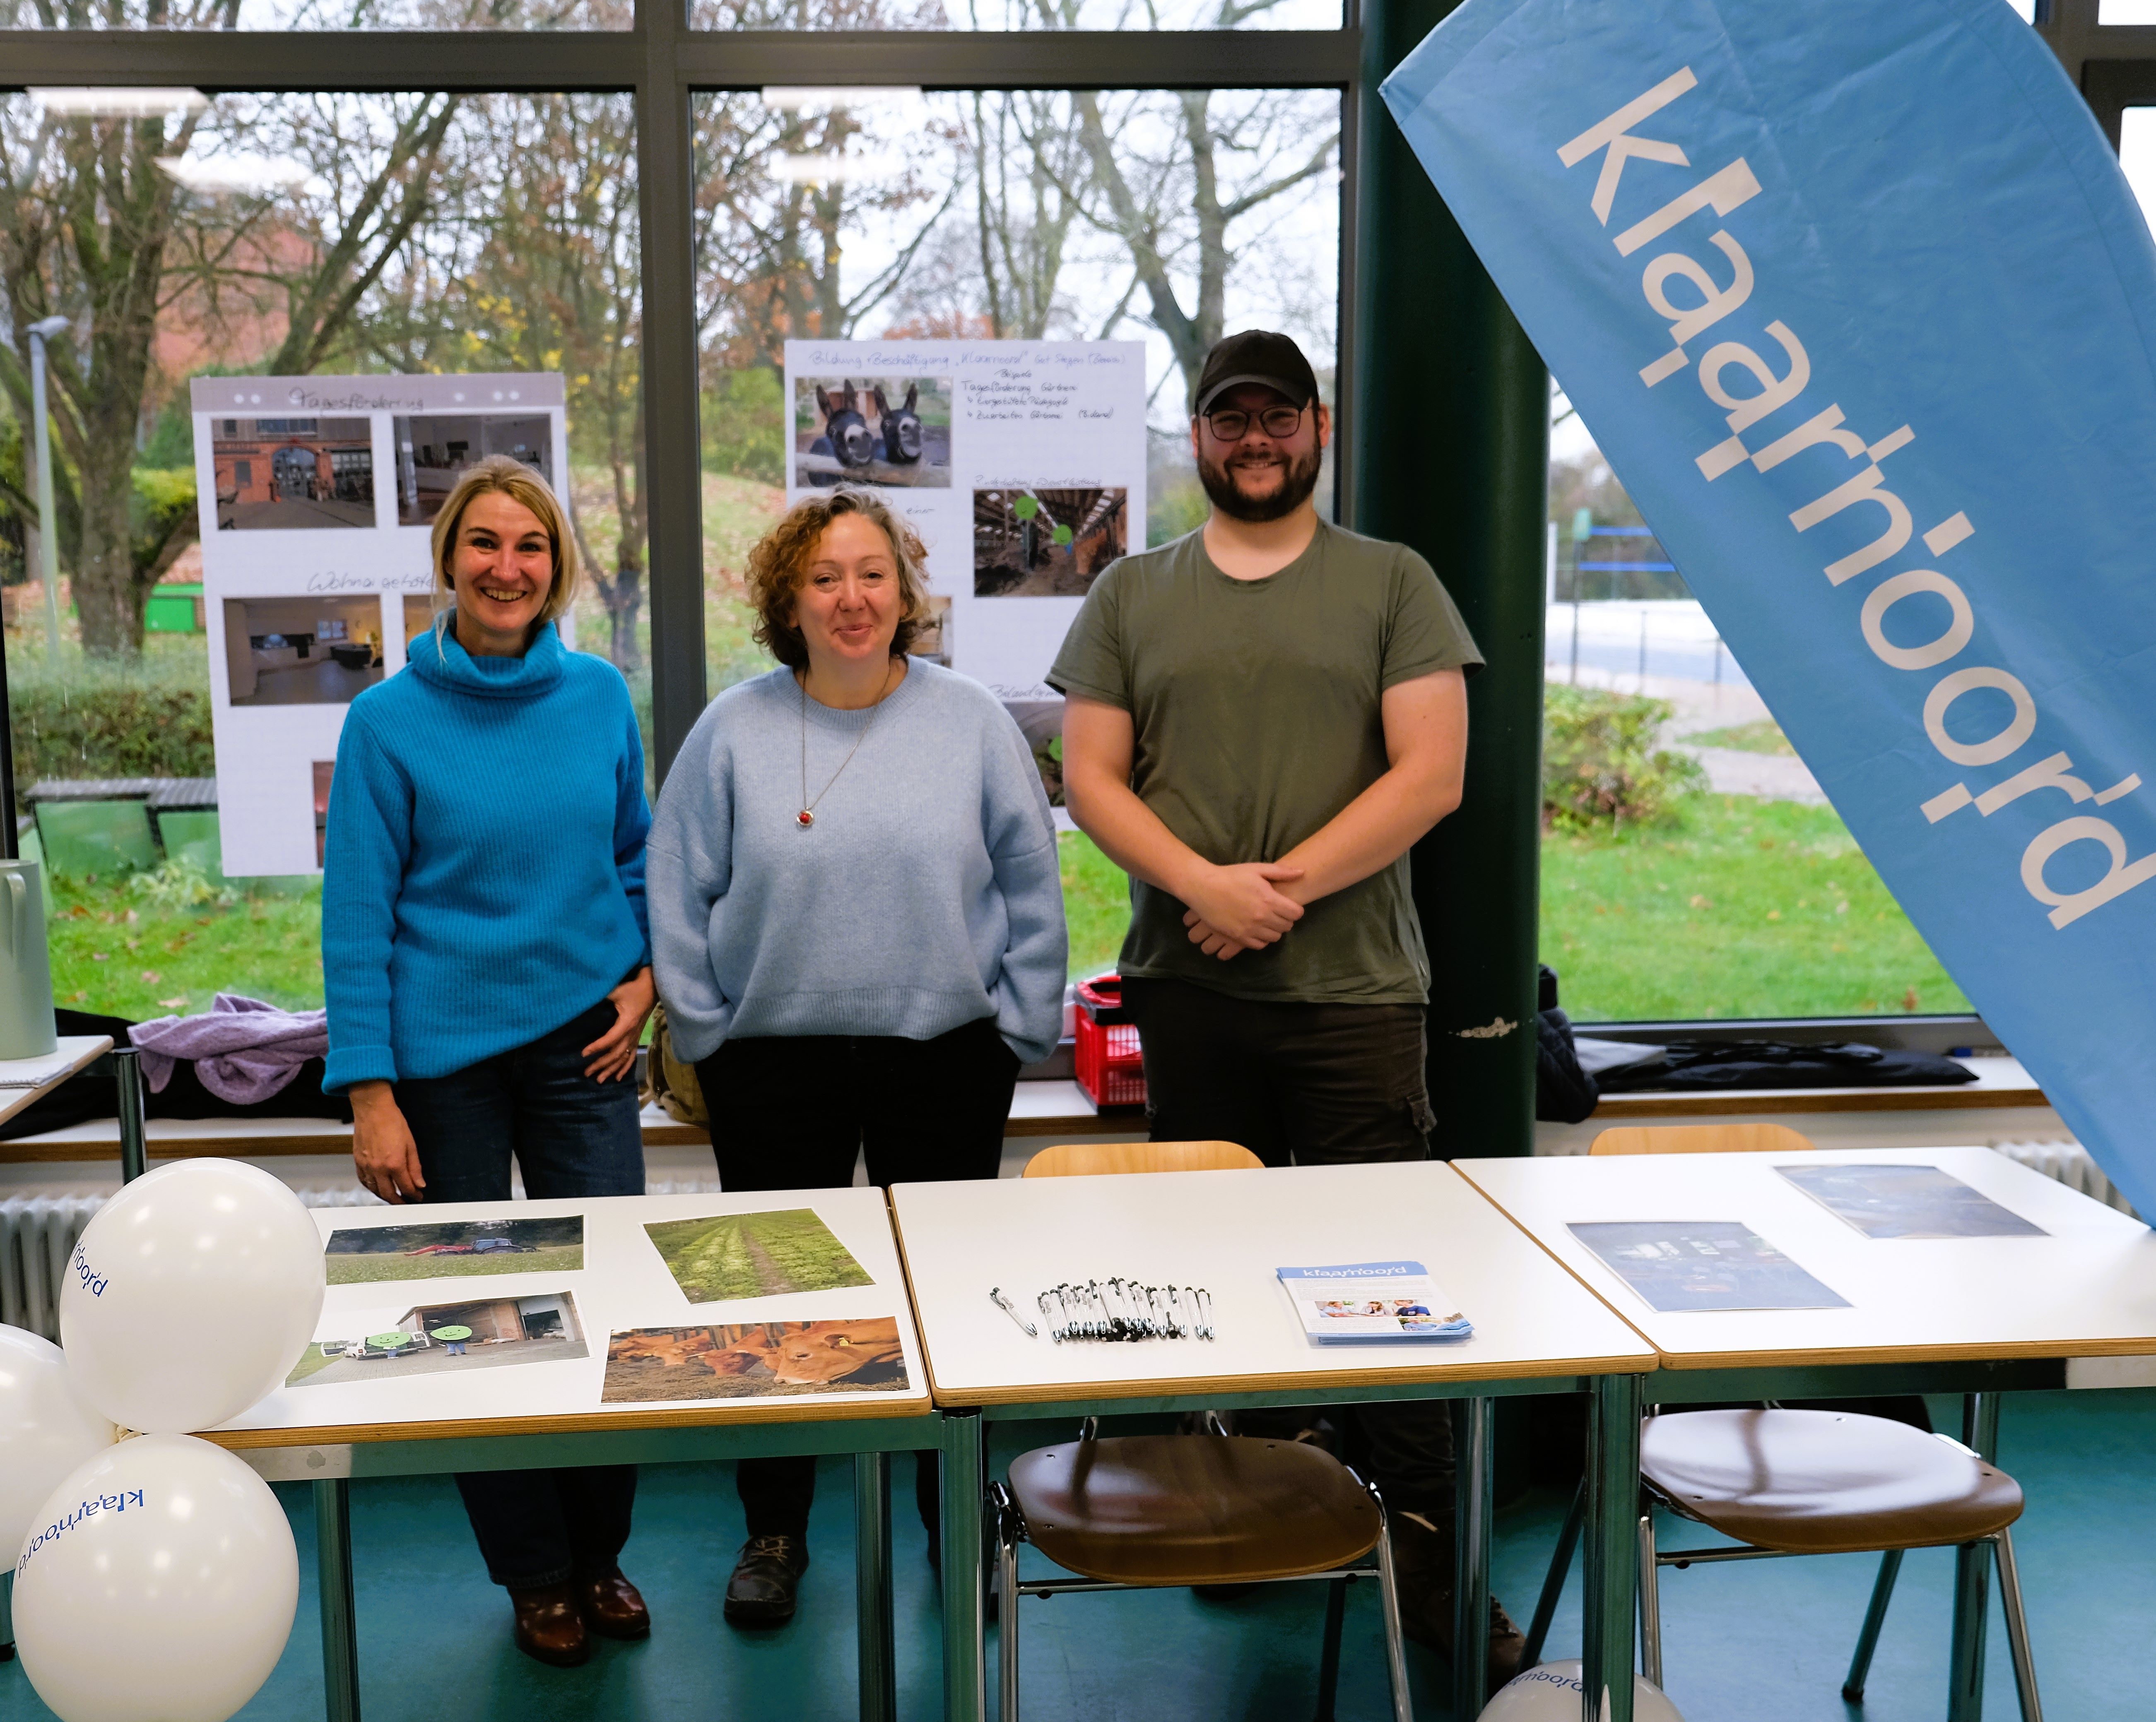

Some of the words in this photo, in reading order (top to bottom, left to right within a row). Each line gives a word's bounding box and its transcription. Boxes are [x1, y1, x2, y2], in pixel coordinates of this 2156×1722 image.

[809, 351, 862, 369] Bildung
[961, 380, 1031, 395] Tagesförderung
[1556, 64, 2156, 931] klaarnoord
[1303, 1266, 1407, 1278] klaarnoord
[19, 1489, 144, 1578] klaarnoord
